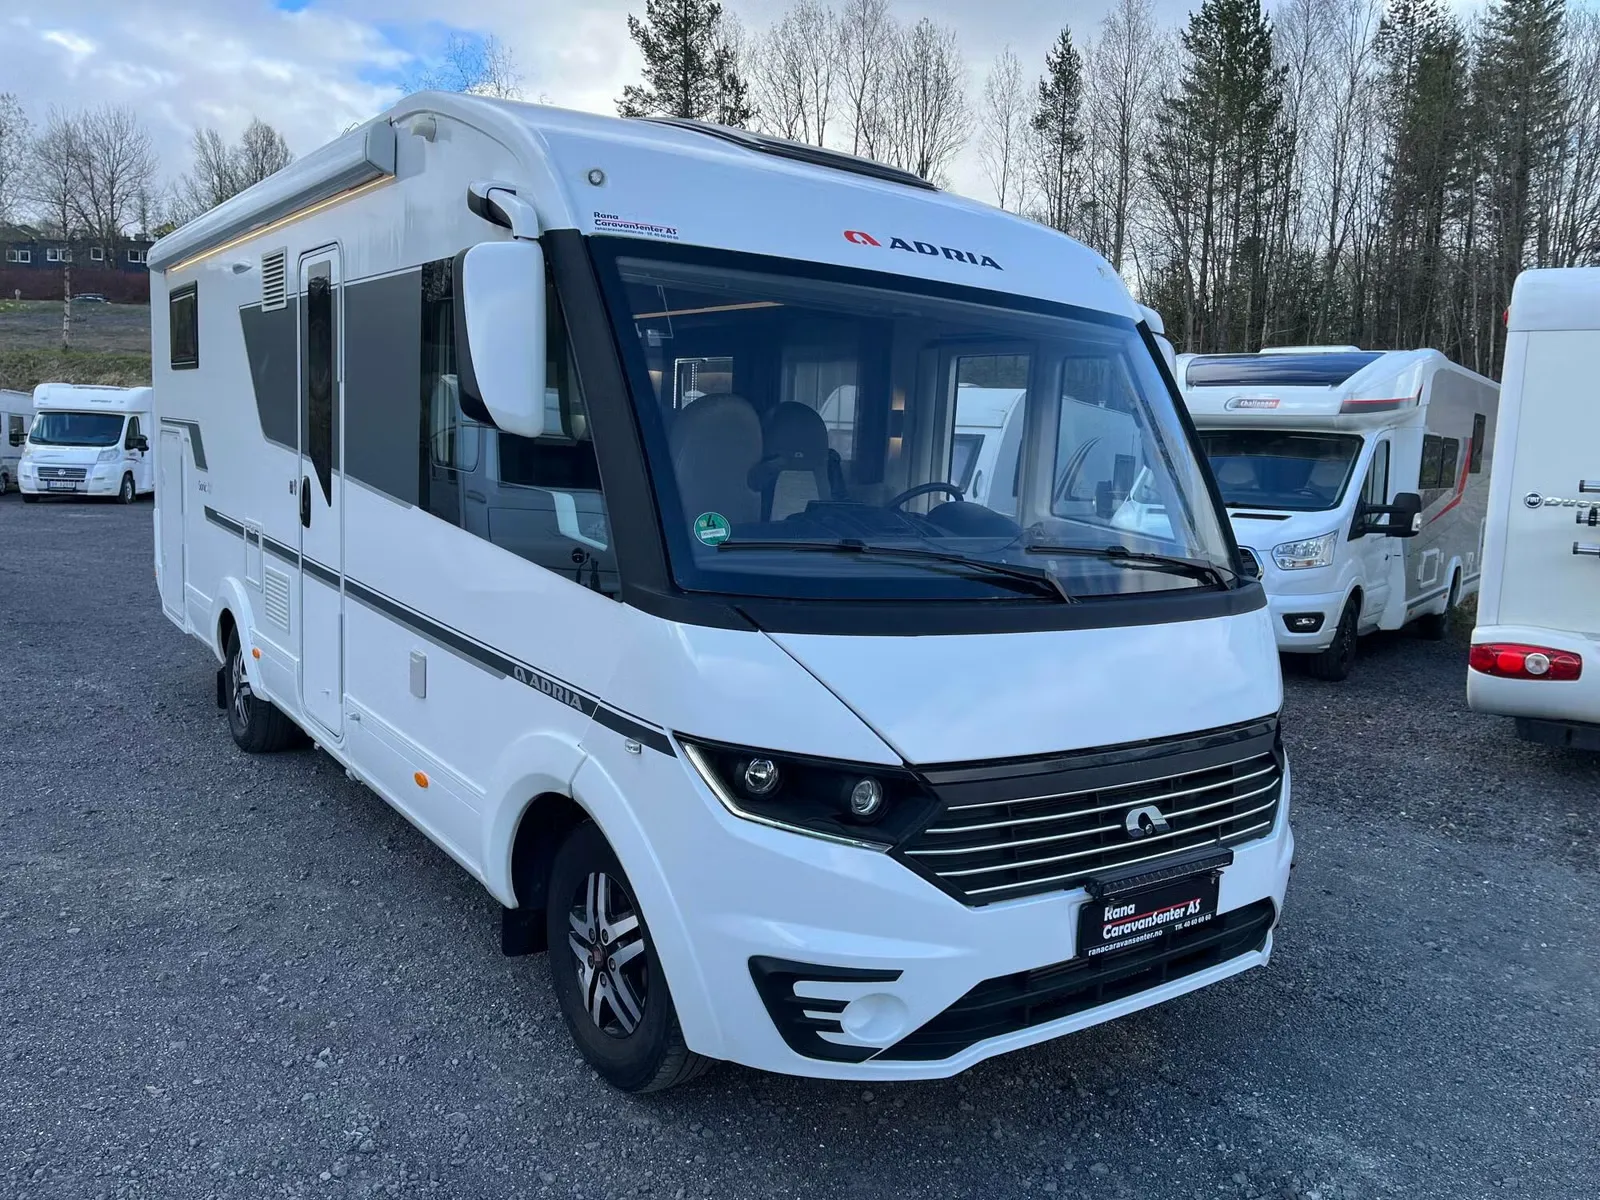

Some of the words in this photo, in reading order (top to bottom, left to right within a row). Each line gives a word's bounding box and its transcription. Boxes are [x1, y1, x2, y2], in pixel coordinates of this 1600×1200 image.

[593, 211, 619, 220] Rana
[594, 219, 663, 233] CaravanSenter
[665, 227, 677, 235] AS
[889, 237, 1004, 271] ADRIA
[529, 673, 583, 711] ADRIA
[1102, 907, 1185, 940] CaravanSenter
[1186, 899, 1200, 916] AS
[1104, 903, 1135, 922] Rana
